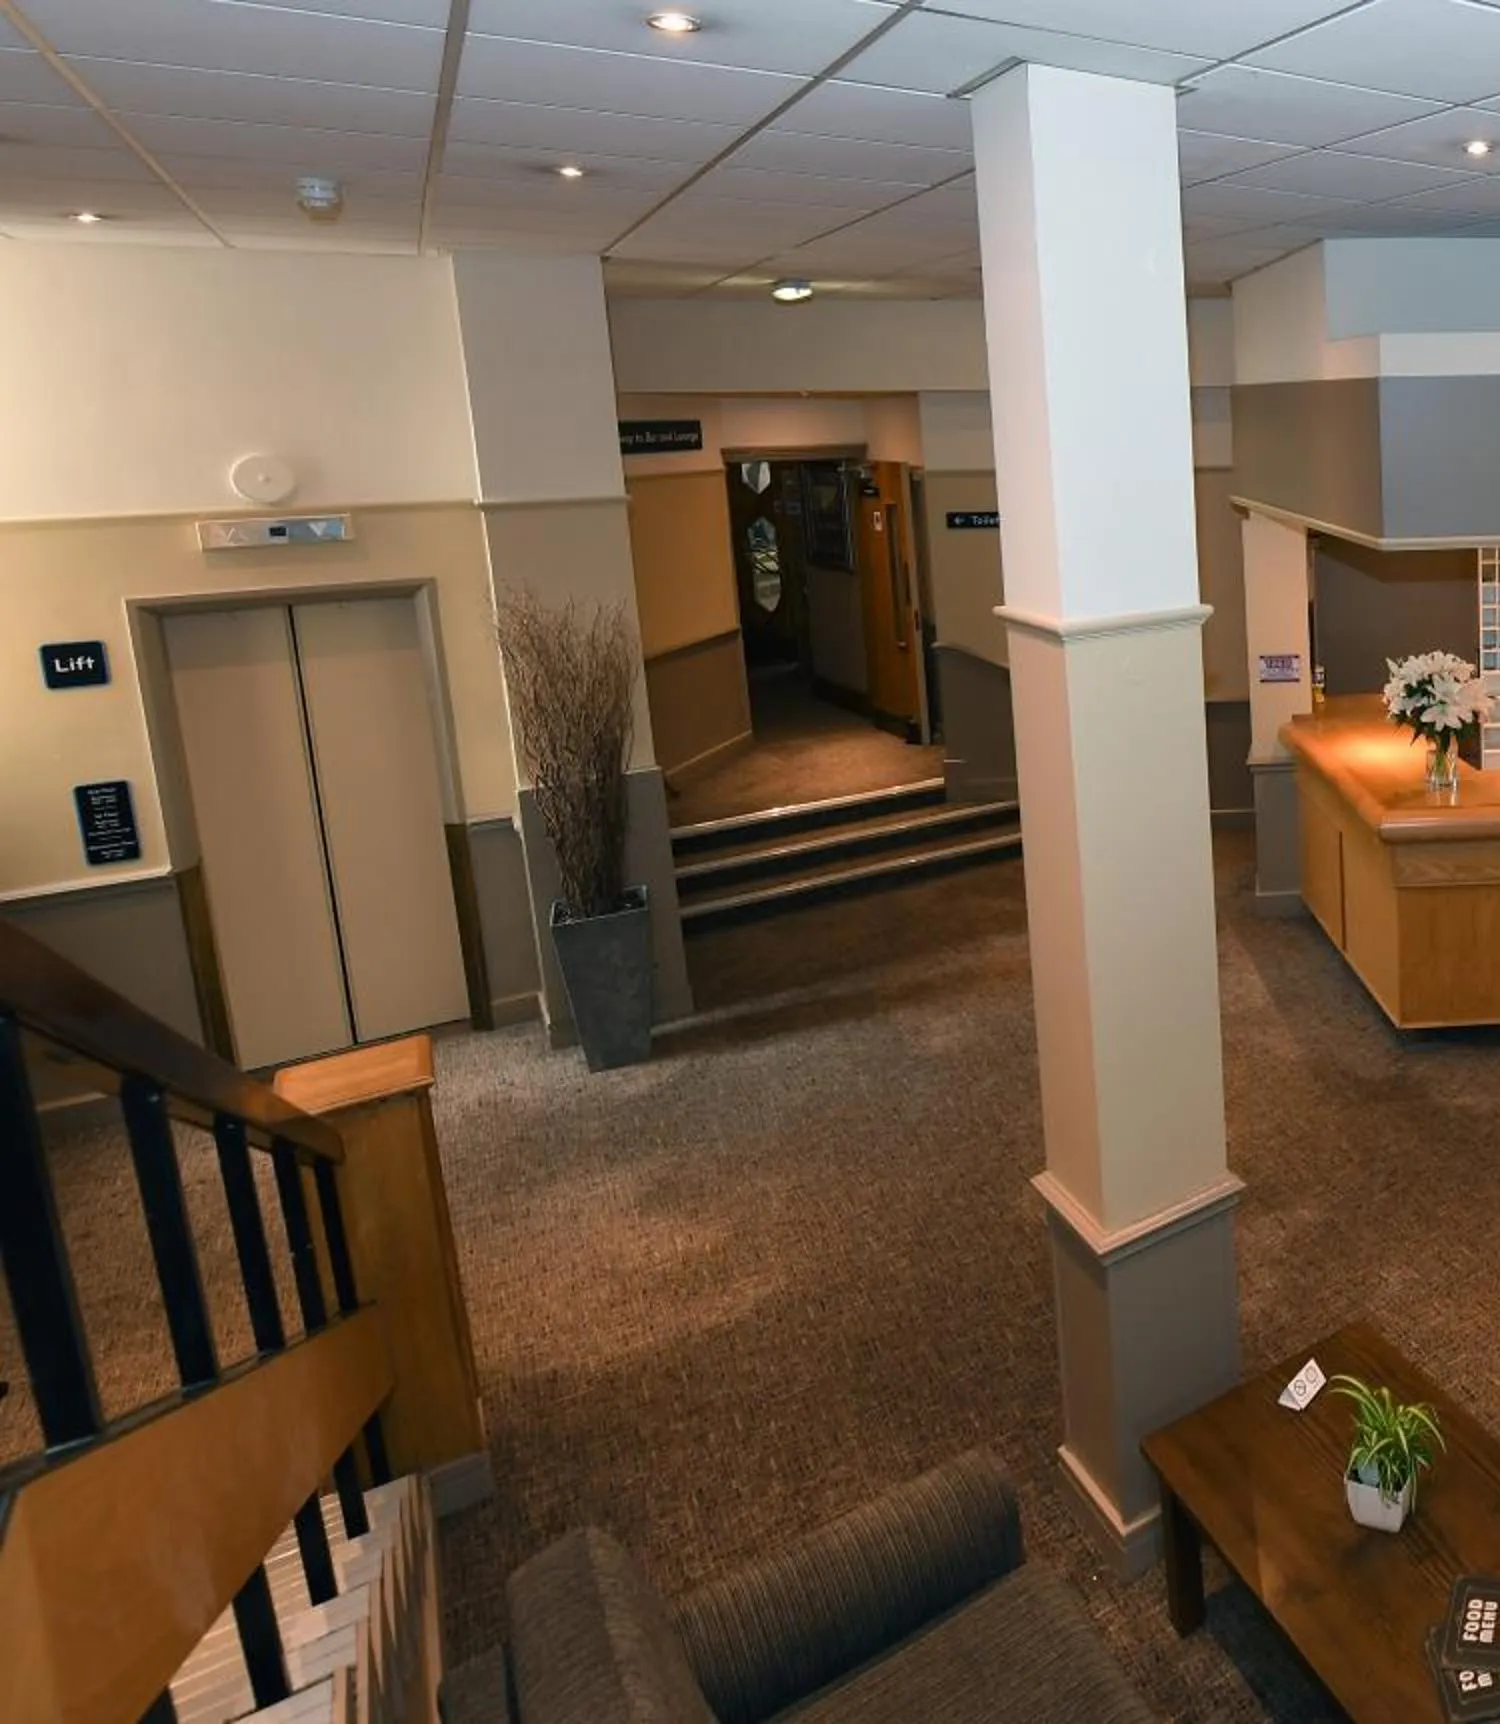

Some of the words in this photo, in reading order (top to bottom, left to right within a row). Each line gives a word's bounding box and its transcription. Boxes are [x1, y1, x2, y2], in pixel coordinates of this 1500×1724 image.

[54, 656, 95, 673] Lift
[1462, 1599, 1483, 1642] FOOD
[1479, 1601, 1499, 1643] MENU
